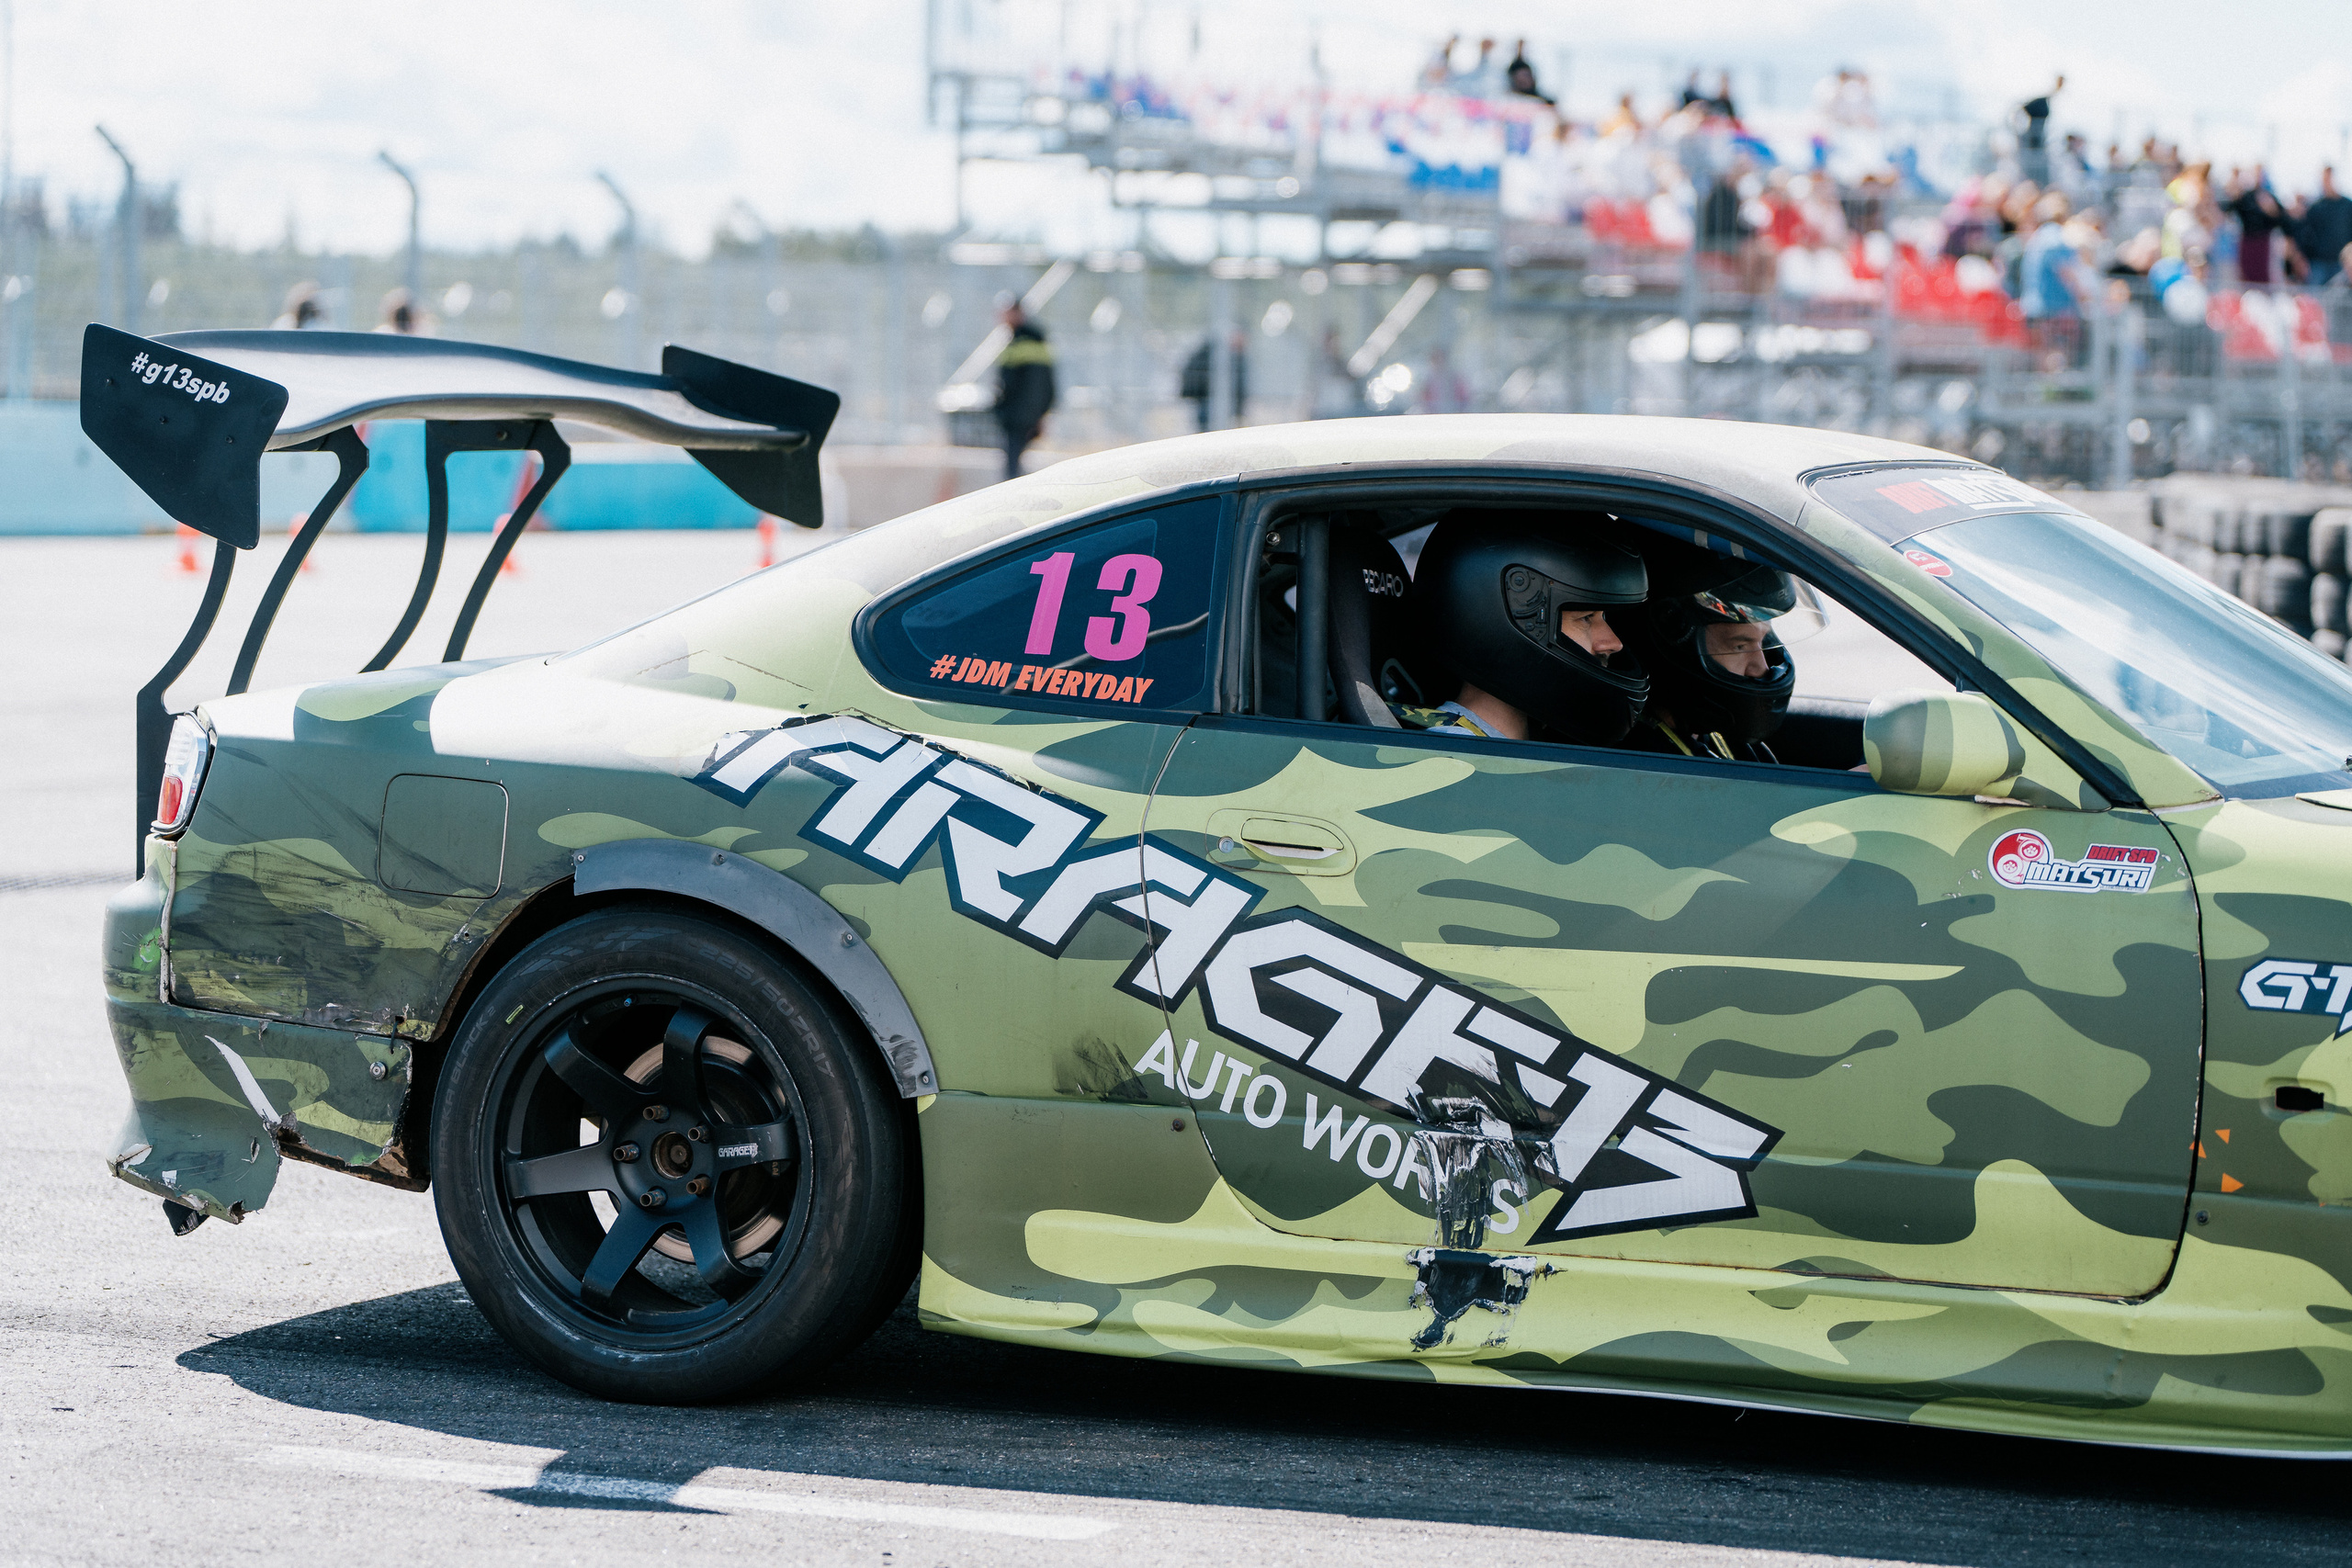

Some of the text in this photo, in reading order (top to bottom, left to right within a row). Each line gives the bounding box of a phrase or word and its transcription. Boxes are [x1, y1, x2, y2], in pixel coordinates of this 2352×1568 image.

[130, 352, 231, 404] #g13spb
[1023, 551, 1163, 661] 13
[930, 654, 1154, 704] #JDM EVERYDAY
[2026, 863, 2149, 888] MATSURI
[2087, 845, 2158, 863] DRIFT SPB
[698, 944, 835, 1078] 225/50ZR17
[451, 1016, 488, 1082] BLACK
[1133, 1028, 1287, 1129] AUTO
